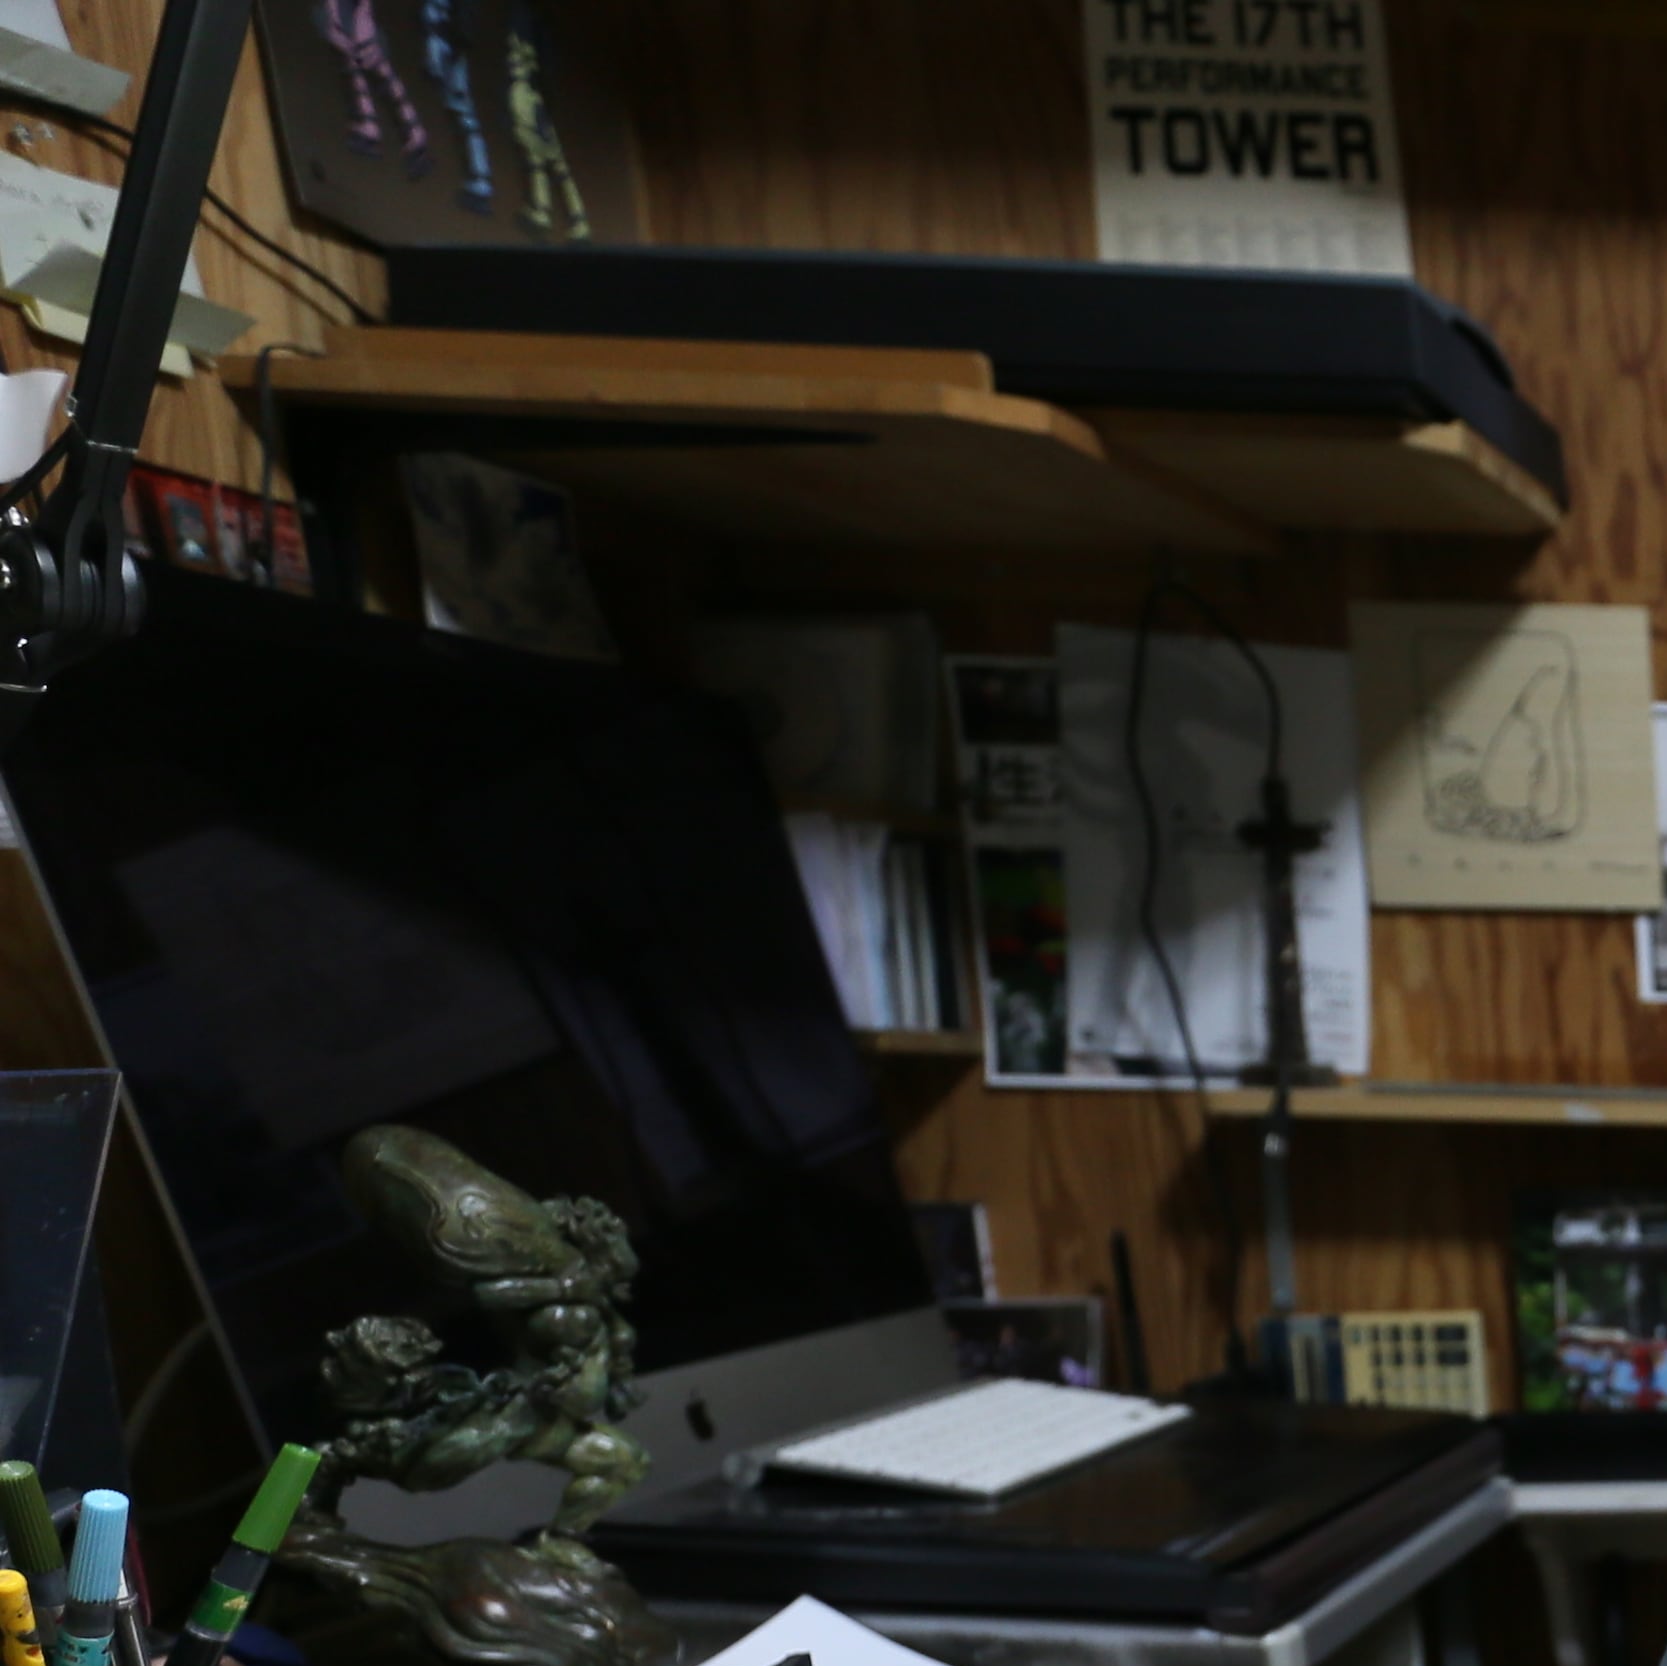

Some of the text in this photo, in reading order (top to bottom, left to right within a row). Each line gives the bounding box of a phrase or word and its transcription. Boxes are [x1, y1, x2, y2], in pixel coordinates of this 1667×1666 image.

[1105, 0, 1364, 49] THE 17TH
[1105, 56, 1368, 98] PERFORMANCE
[1110, 107, 1380, 182] TOWER
